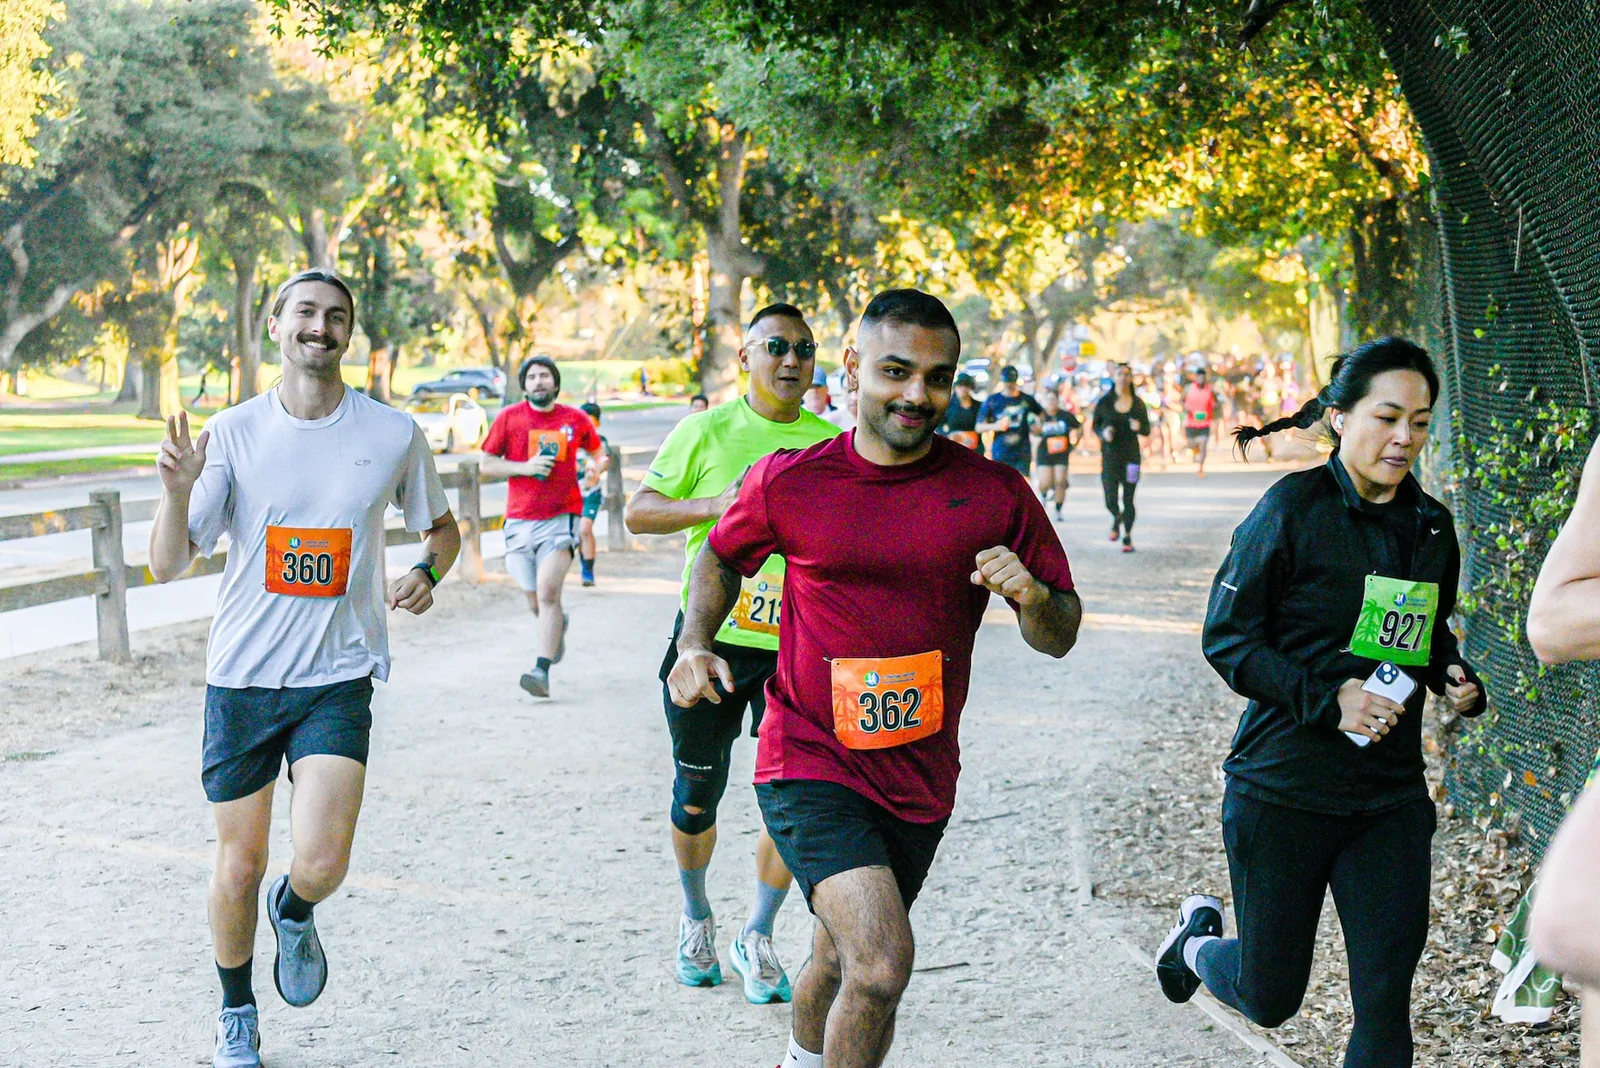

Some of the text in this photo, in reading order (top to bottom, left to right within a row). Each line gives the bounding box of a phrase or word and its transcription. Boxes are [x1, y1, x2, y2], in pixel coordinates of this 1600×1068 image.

[282, 551, 333, 585] 360
[1378, 610, 1427, 651] 927
[858, 686, 922, 734] 362
